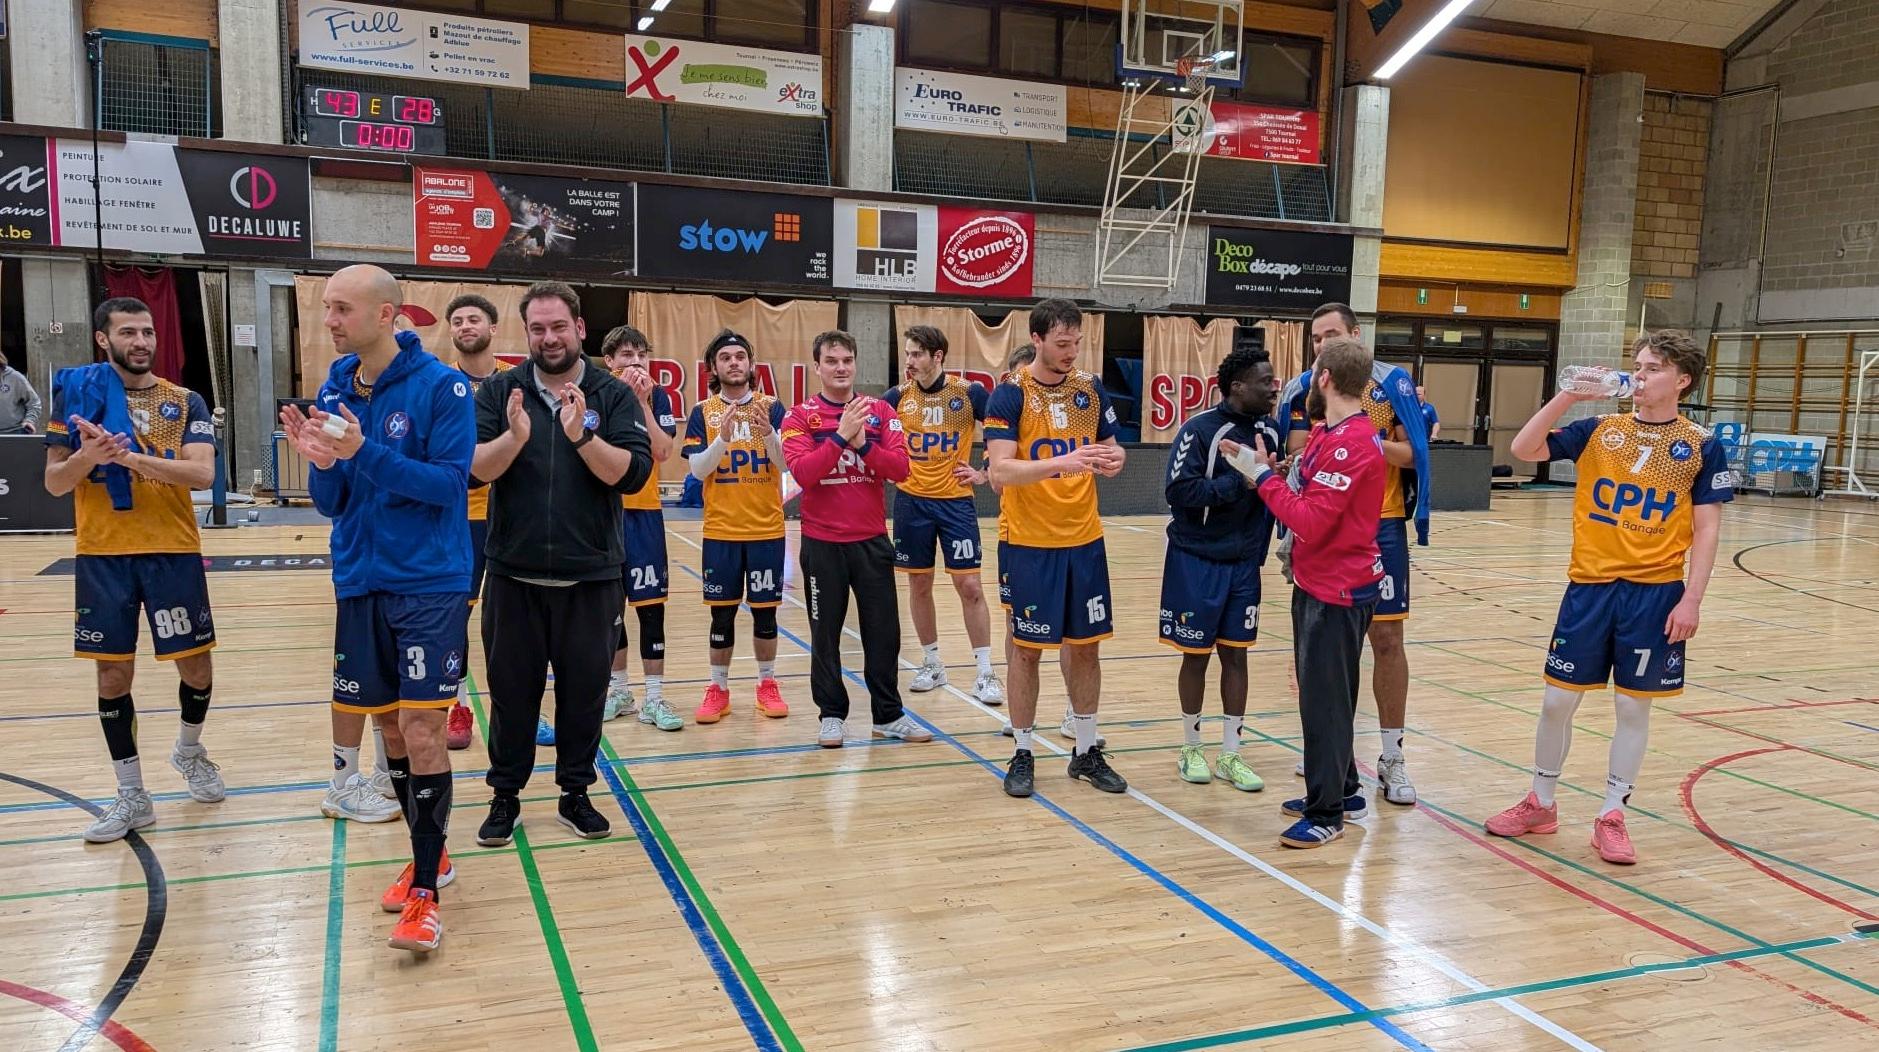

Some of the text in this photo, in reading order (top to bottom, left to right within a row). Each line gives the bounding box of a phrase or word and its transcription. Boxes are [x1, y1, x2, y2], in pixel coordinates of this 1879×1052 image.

[325, 11, 404, 41] Full
[311, 53, 414, 70] www.full-services.be
[703, 84, 726, 99] chez
[1021, 92, 1059, 103] TRANSPORT
[325, 91, 359, 117] 43
[370, 98, 381, 115] E
[402, 97, 434, 122] 28
[795, 102, 817, 112] shop
[947, 102, 1002, 116] TRAFIC
[1022, 106, 1057, 117] LOGISTIQUE
[358, 124, 412, 147] 0:00
[62, 152, 104, 162] PEINTUE
[125, 177, 163, 187] SOLAIRE
[119, 199, 156, 209] FENÊTRE
[569, 198, 620, 208] DANS VOTRE
[578, 190, 603, 198] BALLE
[604, 191, 620, 199] EST
[592, 208, 614, 216] CAMP
[126, 224, 138, 232] DE
[140, 224, 158, 232] SOL
[160, 226, 170, 234] ET
[172, 226, 192, 235] MUR
[208, 216, 301, 238] DECALUWE
[679, 218, 769, 255] stow
[981, 222, 1002, 234] depuis
[957, 235, 1015, 265] Storme
[1215, 238, 1254, 257] Deco
[810, 258, 826, 266] rack
[814, 264, 826, 272] the
[875, 257, 917, 278] HLB
[1218, 255, 1302, 280] Box décape
[806, 271, 830, 279] world.
[856, 274, 917, 284] HOME INTERIOR
[922, 406, 945, 426] 20
[908, 432, 960, 453] CPH
[1630, 444, 1653, 474] 7
[1593, 478, 1677, 522] CPH
[1622, 520, 1666, 536] Banque
[952, 539, 974, 560] 20
[630, 565, 659, 590] 24
[750, 569, 775, 593] 34
[809, 576, 819, 620] Kempa
[1086, 595, 1106, 624] 15
[154, 606, 192, 639] 98
[1016, 617, 1050, 634] Tesse
[406, 646, 426, 680] 3
[1633, 648, 1652, 677] 7
